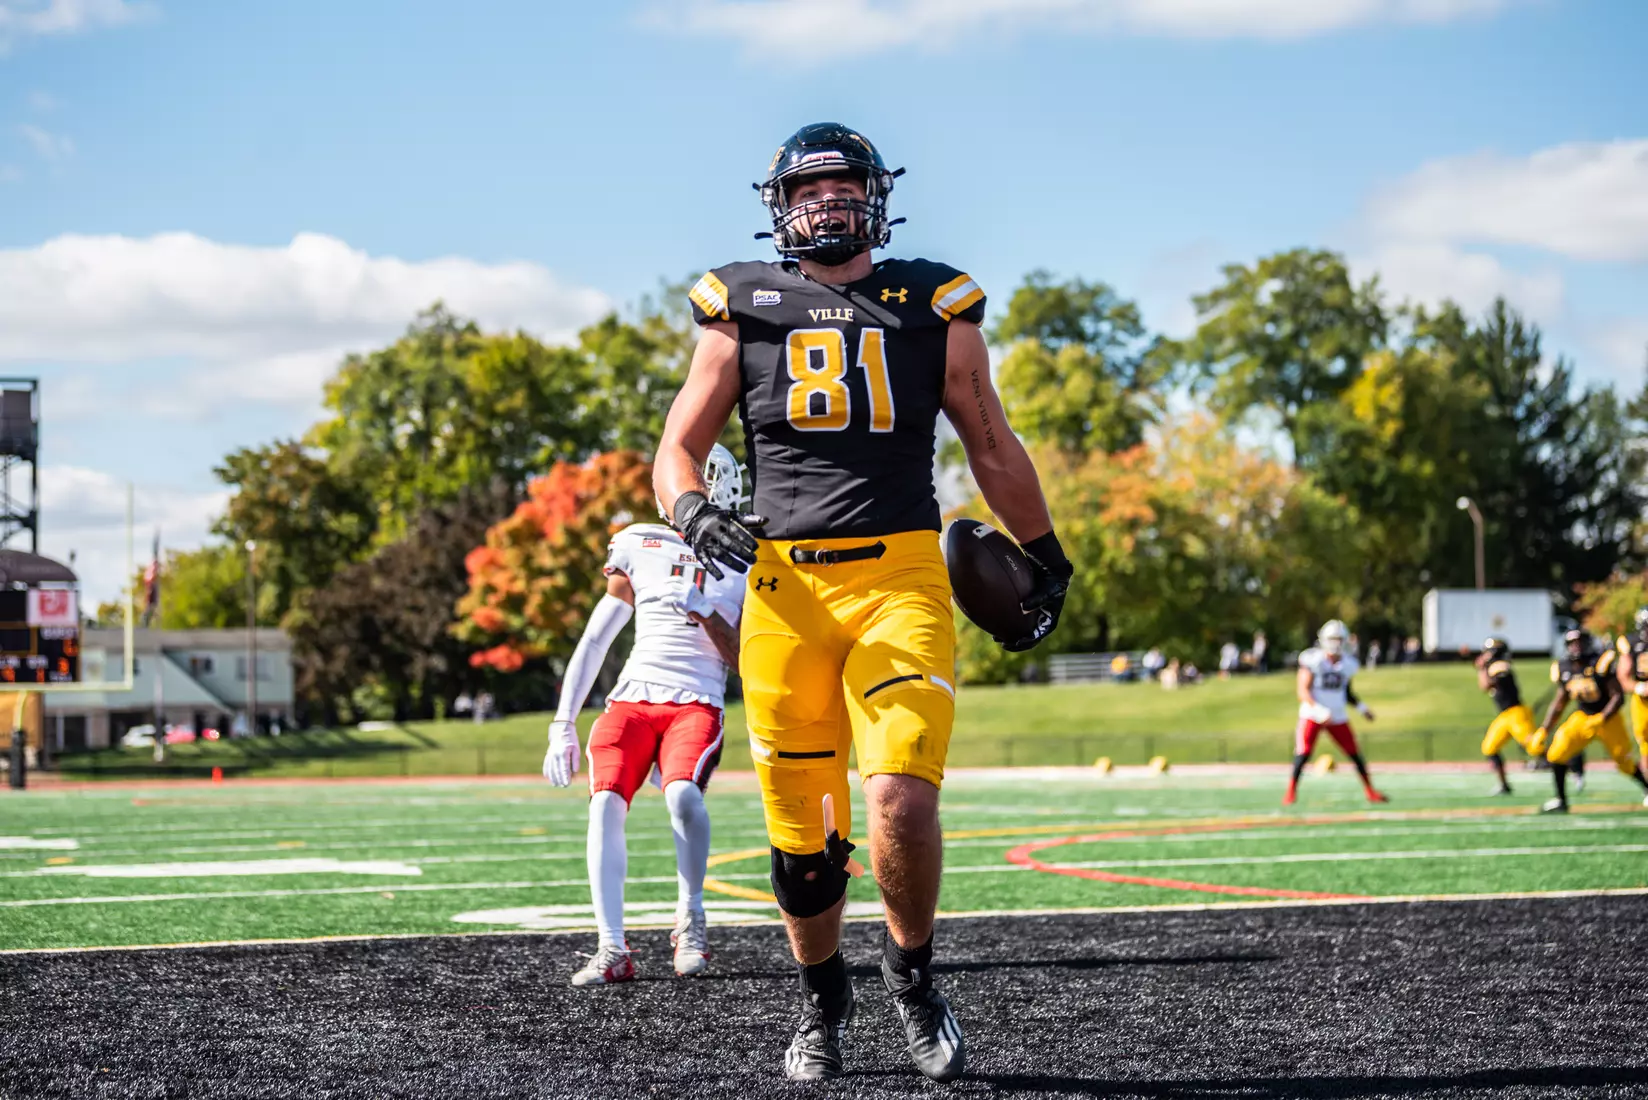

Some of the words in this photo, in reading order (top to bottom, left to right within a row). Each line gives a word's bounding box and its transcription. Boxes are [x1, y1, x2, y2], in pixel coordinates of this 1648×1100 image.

[808, 308, 854, 322] VILLE
[786, 327, 895, 433] 81
[971, 369, 982, 399] VENI
[979, 400, 990, 426] VIDI
[985, 427, 997, 450] VICI
